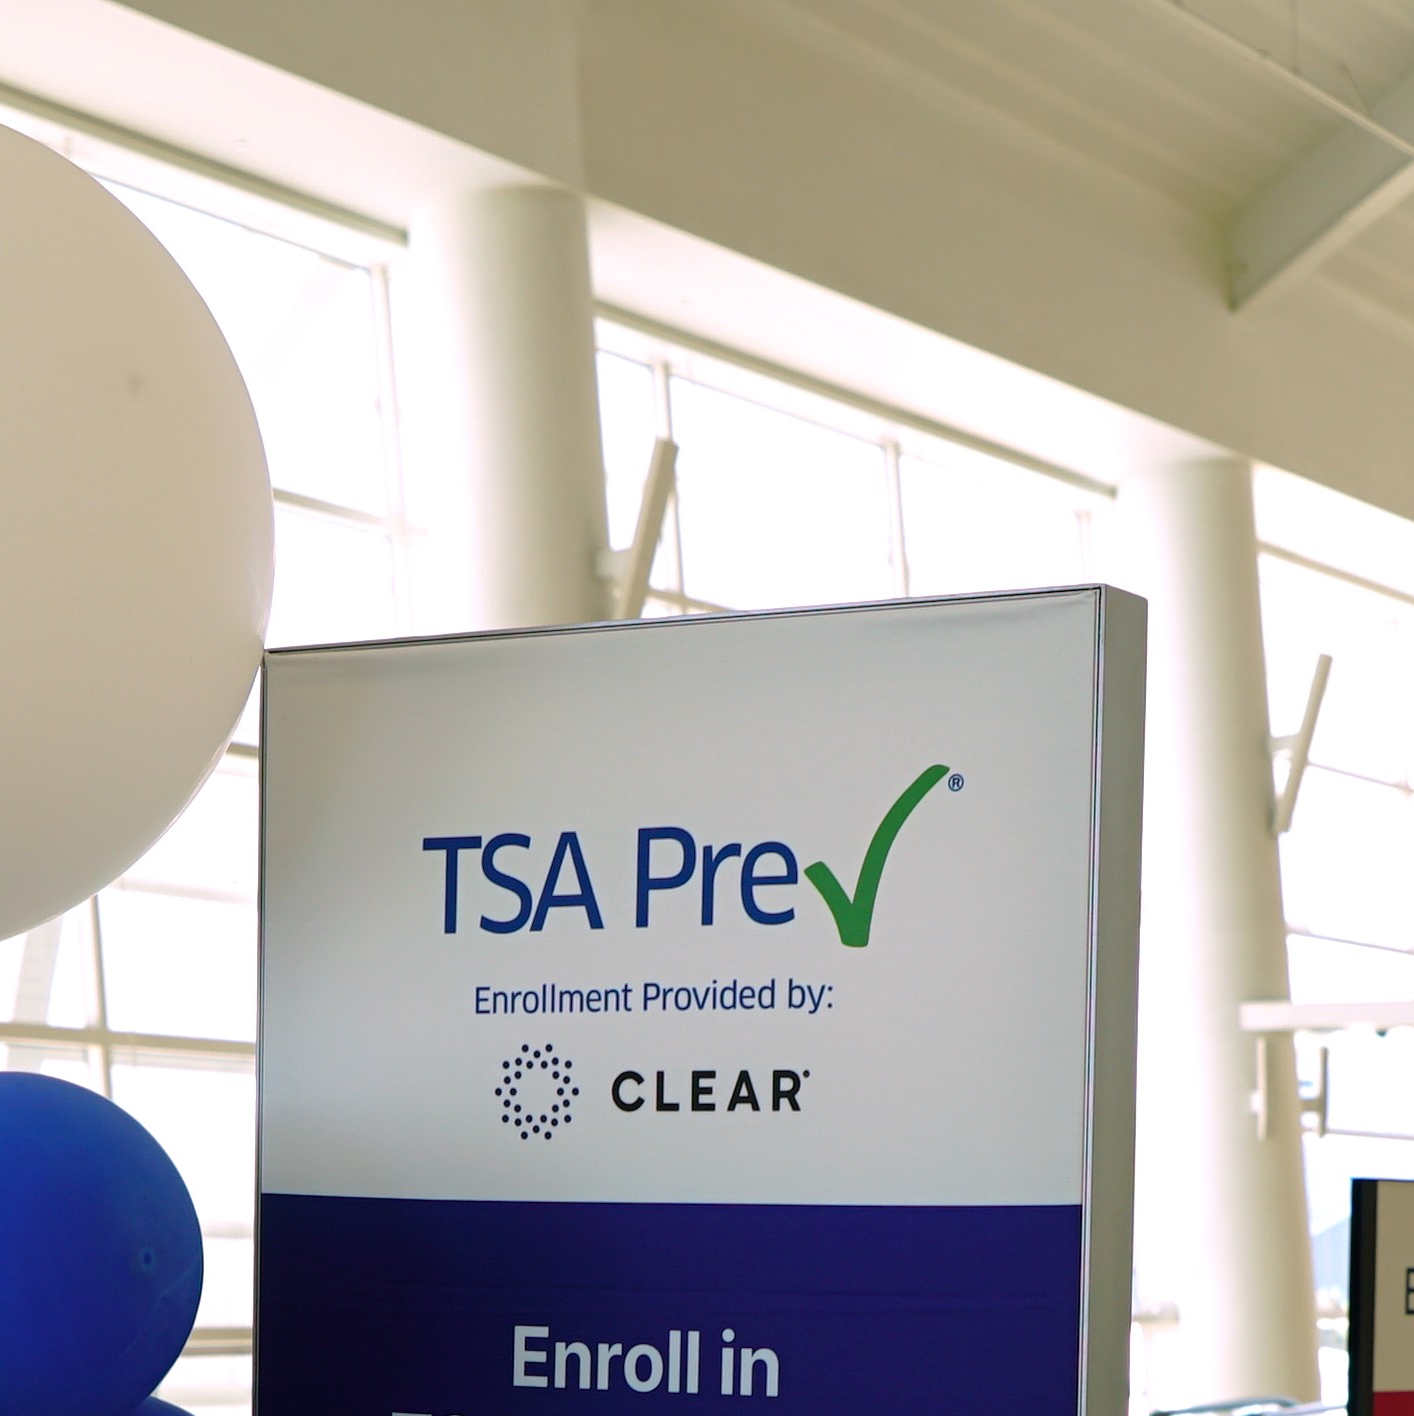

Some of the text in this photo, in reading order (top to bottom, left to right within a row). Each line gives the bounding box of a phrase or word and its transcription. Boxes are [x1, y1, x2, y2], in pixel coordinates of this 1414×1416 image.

[423, 832, 604, 934] TSA
[475, 978, 833, 1014] Enrollment Provided by:
[513, 1326, 780, 1397] Enroll in
